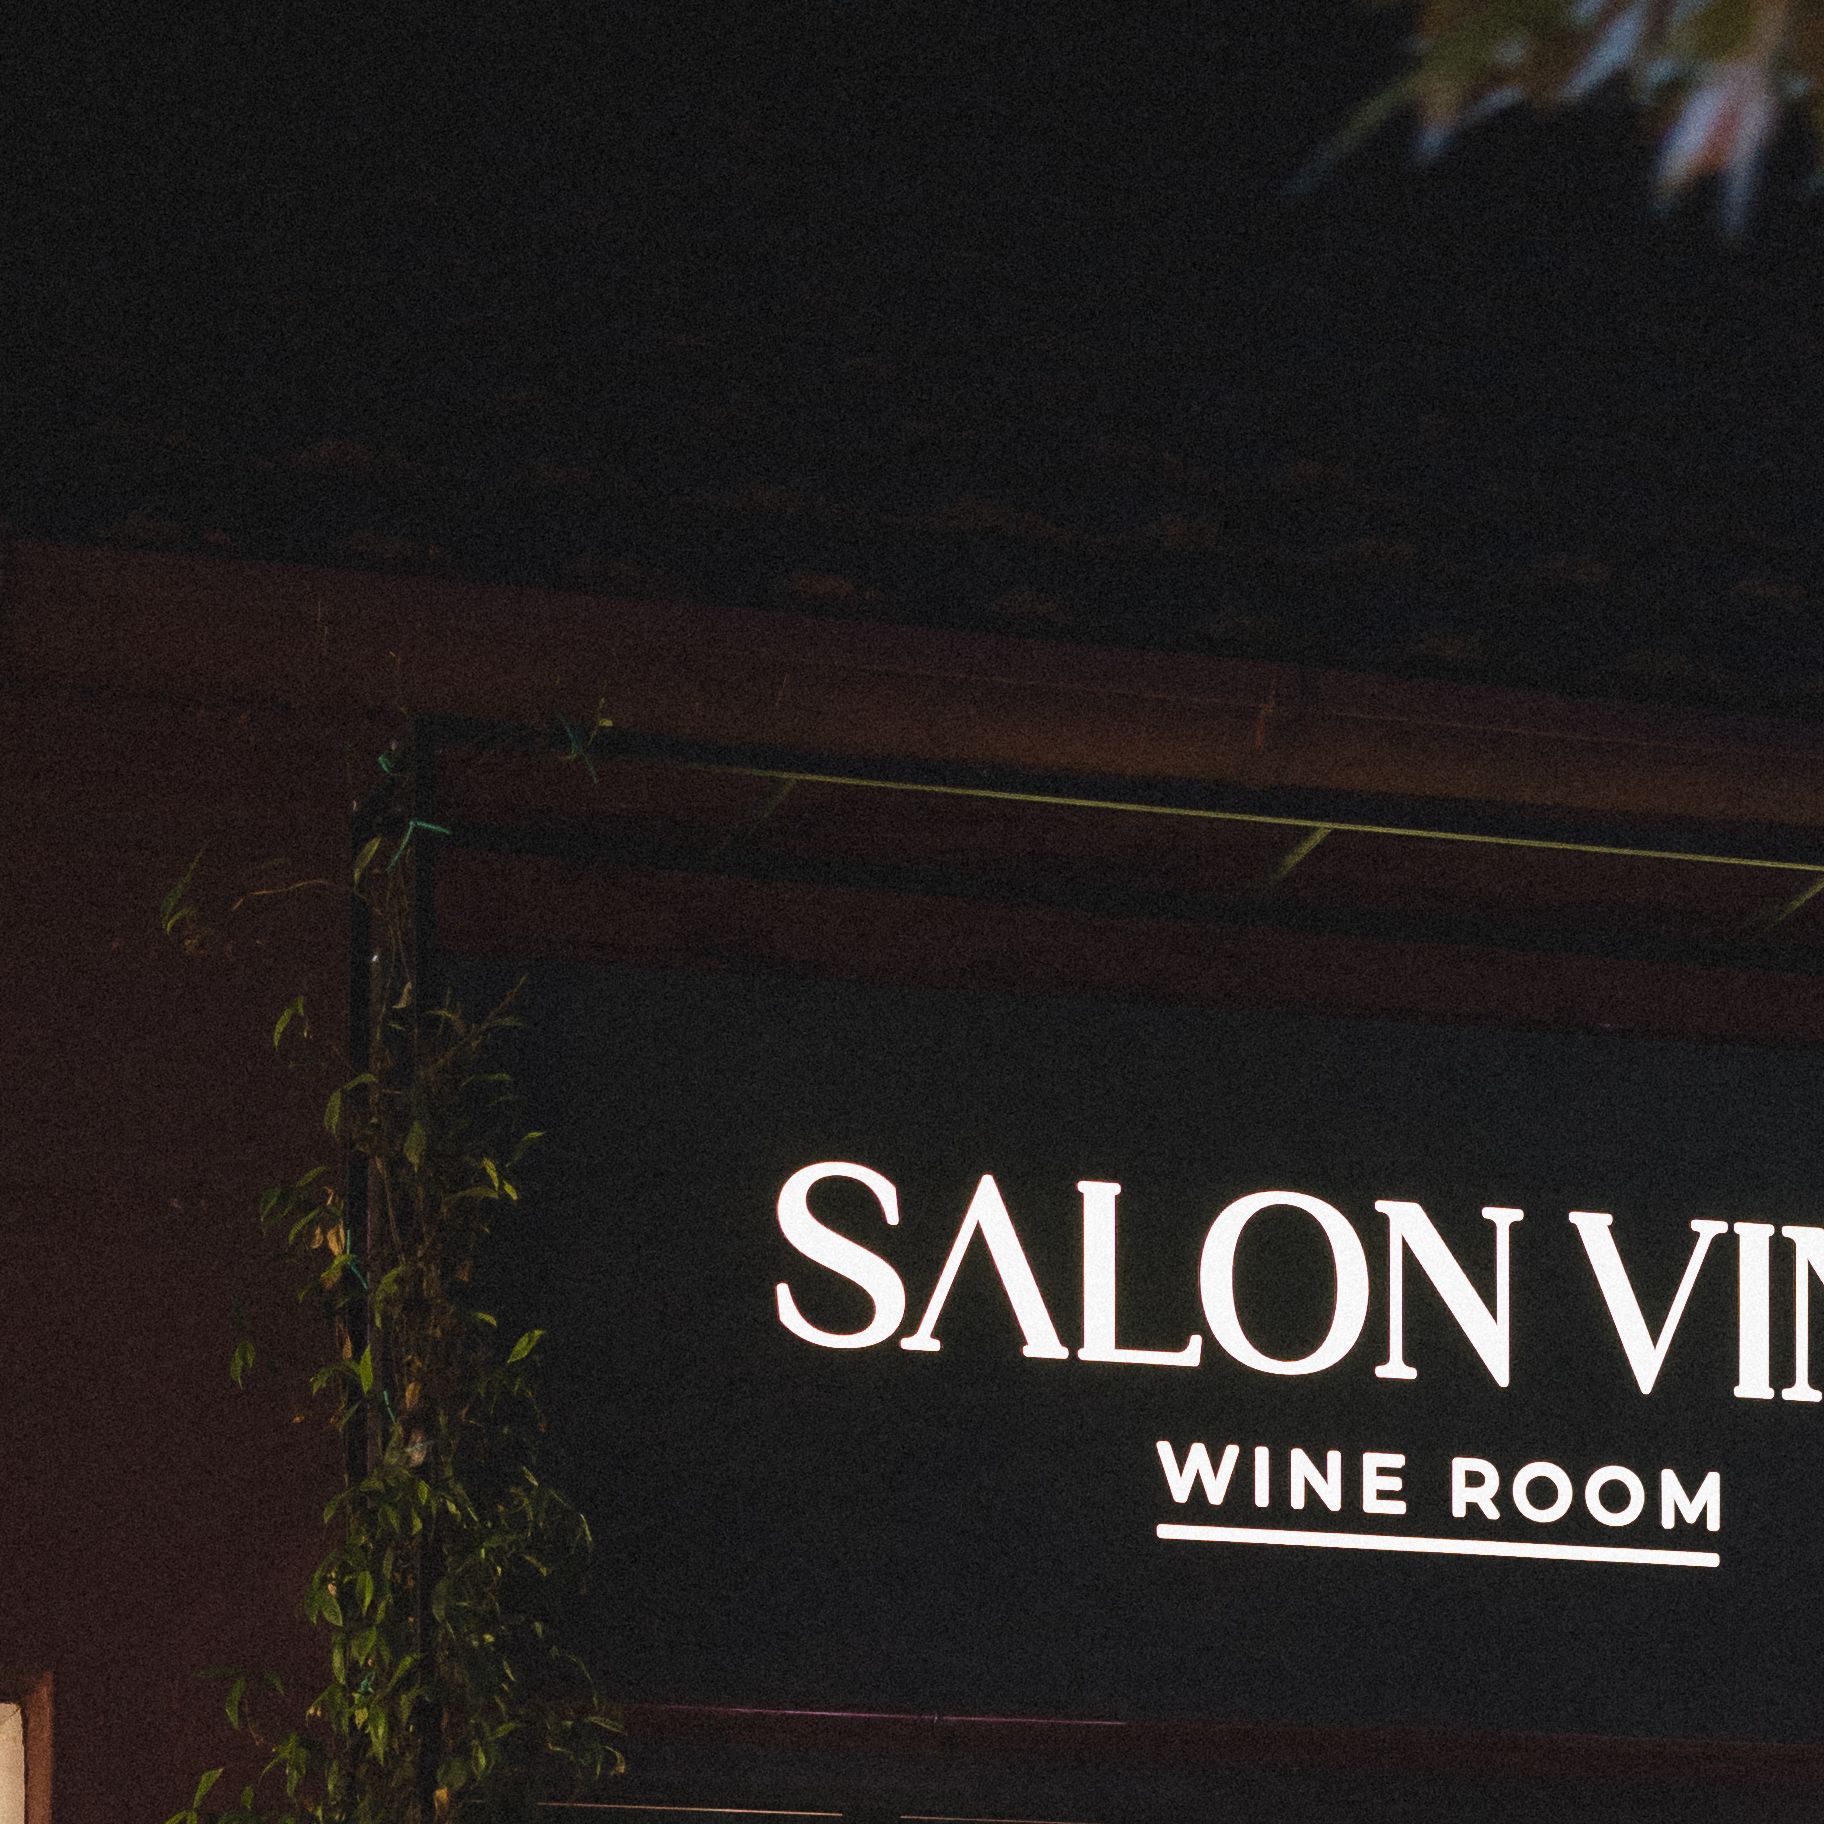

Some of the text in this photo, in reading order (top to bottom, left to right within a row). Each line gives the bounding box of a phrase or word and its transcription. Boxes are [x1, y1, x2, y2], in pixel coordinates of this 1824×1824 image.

[775, 1161, 1525, 1388] SALON
[1155, 1440, 1721, 1532] WINE ROOM
